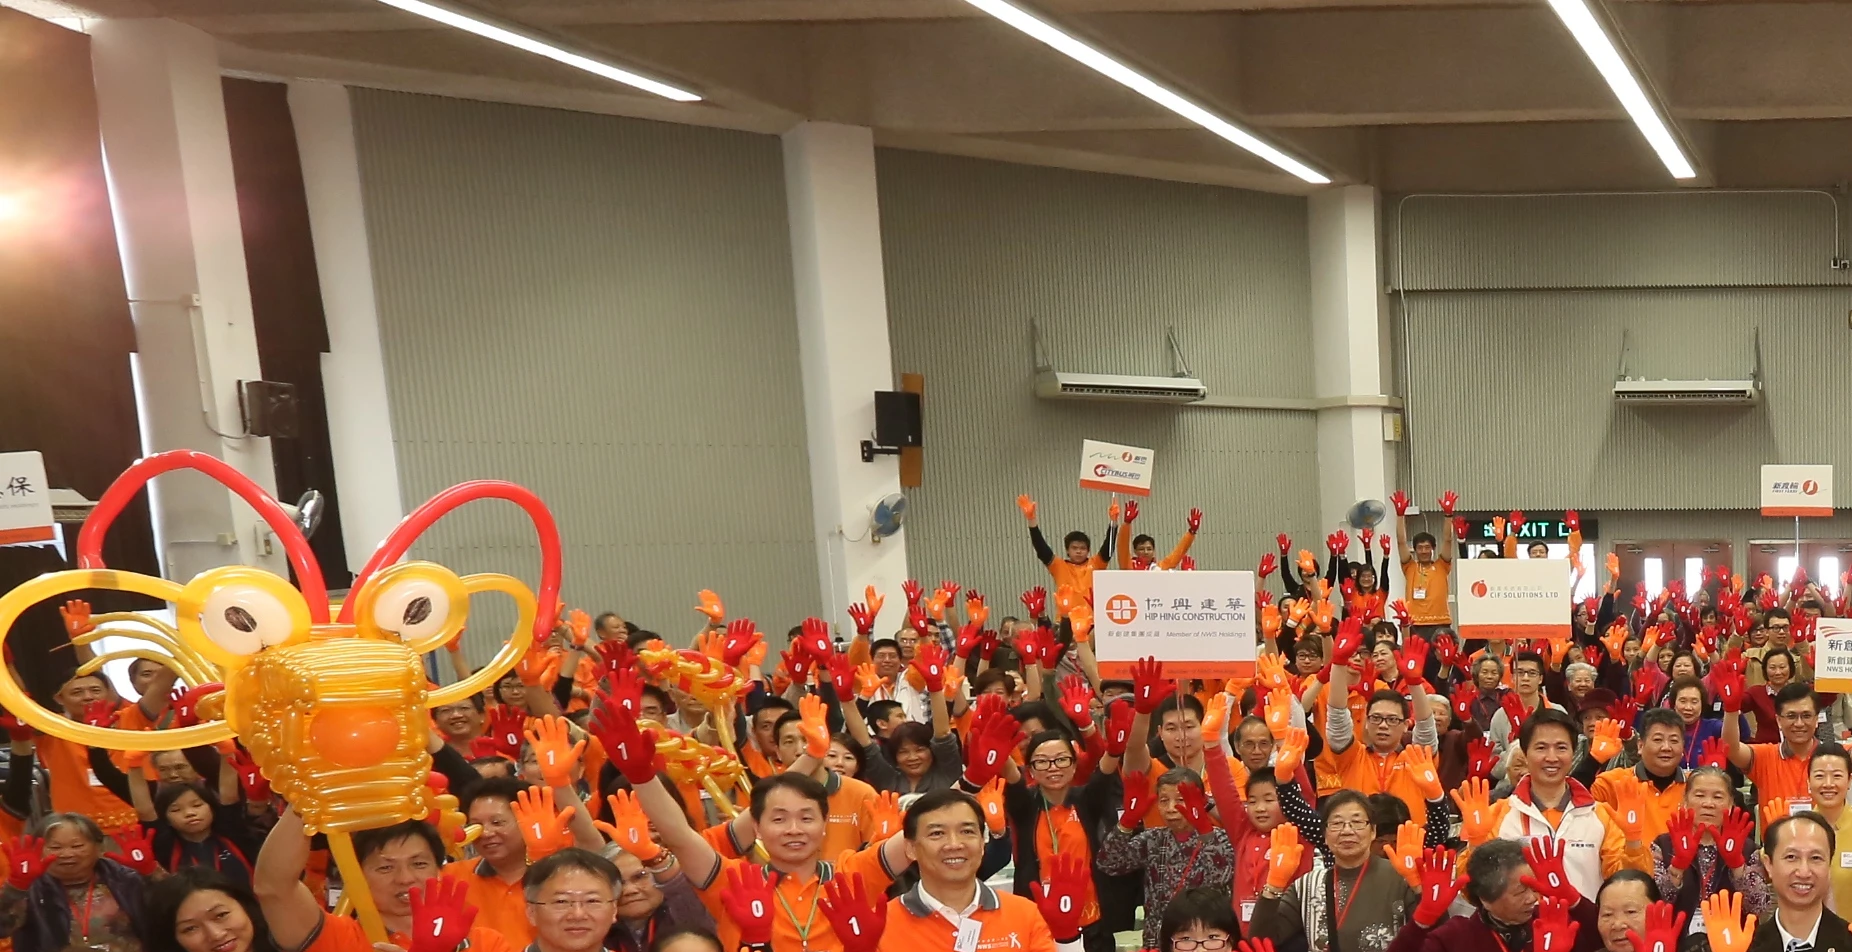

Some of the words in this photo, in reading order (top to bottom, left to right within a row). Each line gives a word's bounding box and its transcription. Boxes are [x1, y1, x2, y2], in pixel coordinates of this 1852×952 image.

[1100, 468, 1128, 478] CITYBUS
[0, 476, 35, 499] 保
[1144, 598, 1246, 611] 協興建築
[1144, 612, 1158, 621] HIP
[1160, 612, 1180, 621] HING
[1182, 612, 1246, 621] CONSTRUCTION
[1219, 631, 1247, 639] Holdings
[522, 660, 527, 670] 1
[1826, 665, 1844, 673] NWS
[837, 676, 841, 686] 1
[1144, 686, 1149, 697] 1
[1725, 685, 1730, 695] 1
[1514, 716, 1520, 726] 1
[507, 734, 517, 744] 0
[1118, 730, 1124, 742] 0
[618, 742, 627, 760] 1
[987, 750, 996, 764] 0
[547, 750, 554, 765] 1
[1477, 761, 1481, 771] 1
[248, 773, 254, 784] 1
[1424, 770, 1434, 782] 0
[989, 802, 997, 814] 0
[1131, 798, 1136, 809] 1
[1474, 811, 1480, 824] 1
[1628, 811, 1636, 823] 0
[532, 823, 541, 839] 1
[882, 821, 887, 833] 1
[629, 828, 638, 843] 0
[1682, 836, 1687, 849] 1
[1726, 839, 1734, 851] 0
[132, 850, 143, 860] 0
[1277, 854, 1283, 866] 1
[21, 861, 27, 873] 1
[1405, 856, 1414, 868] 0
[1548, 873, 1559, 887] 0
[1433, 885, 1439, 900] 1
[752, 901, 763, 917] 0
[1060, 896, 1071, 912] 0
[434, 918, 443, 936] 1
[849, 917, 859, 935] 1
[1544, 933, 1551, 950] 1
[1723, 928, 1731, 944] 1
